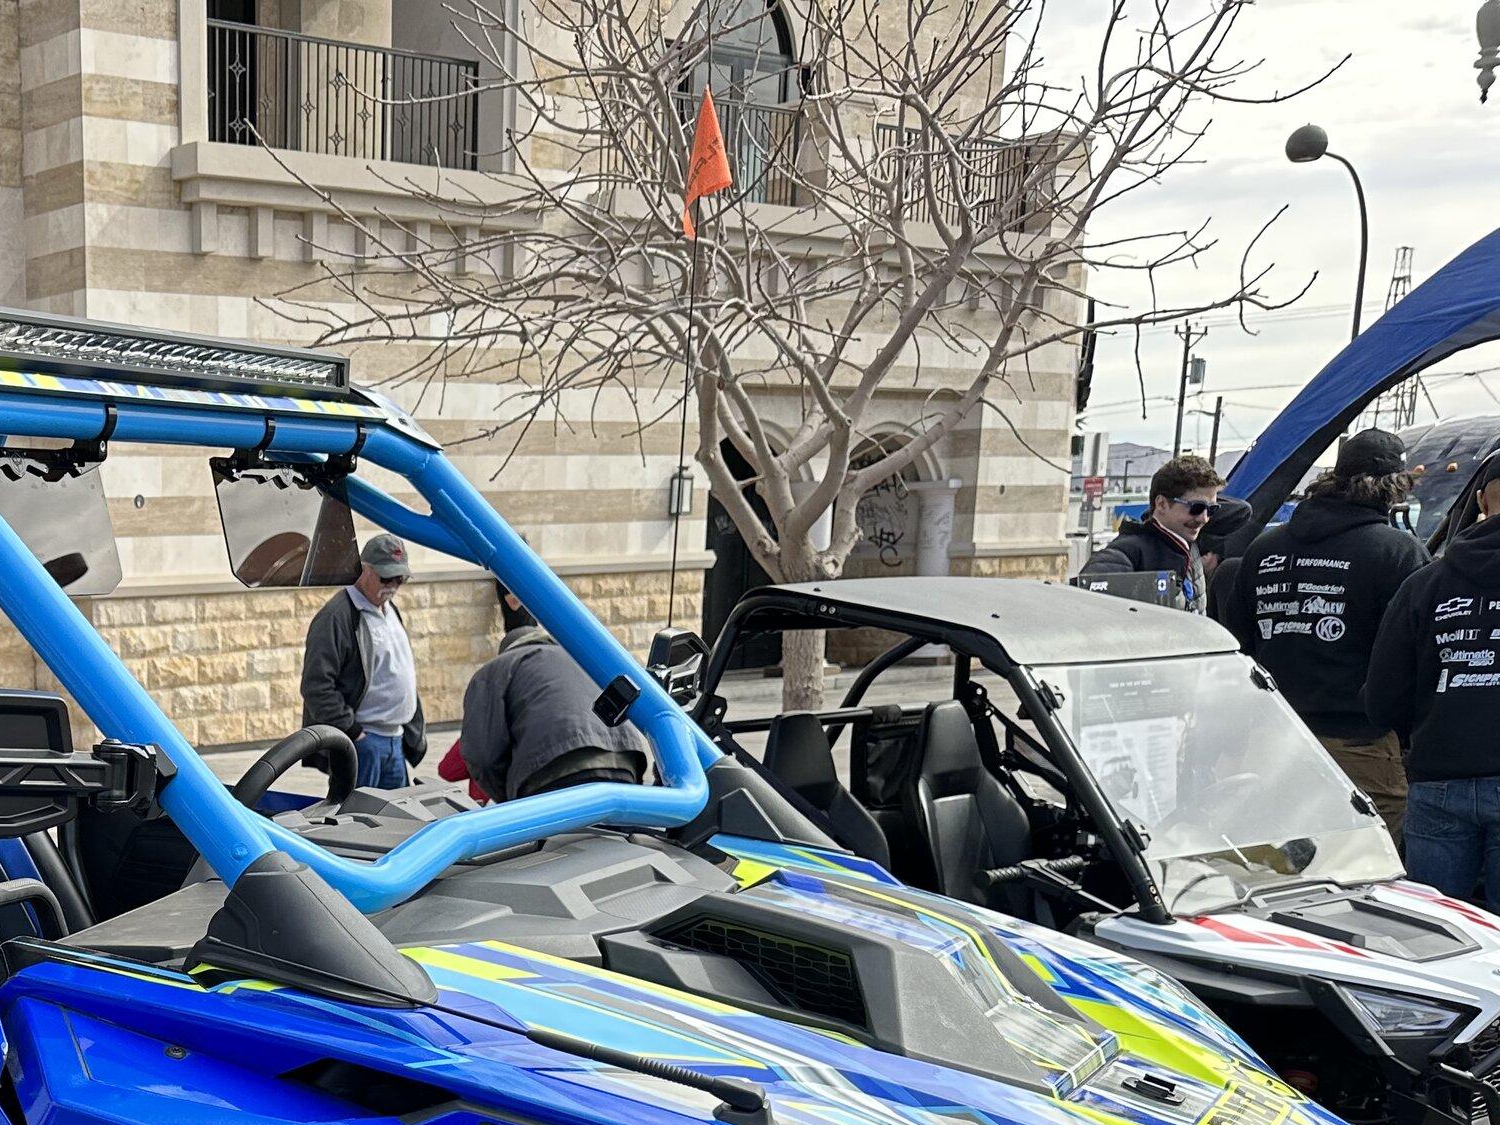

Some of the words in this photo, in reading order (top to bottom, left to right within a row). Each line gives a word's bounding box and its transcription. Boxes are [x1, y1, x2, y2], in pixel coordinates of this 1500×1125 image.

[1296, 558, 1351, 570] PERFORMANCE
[1256, 583, 1278, 596] Mobil
[1320, 619, 1341, 638] KC
